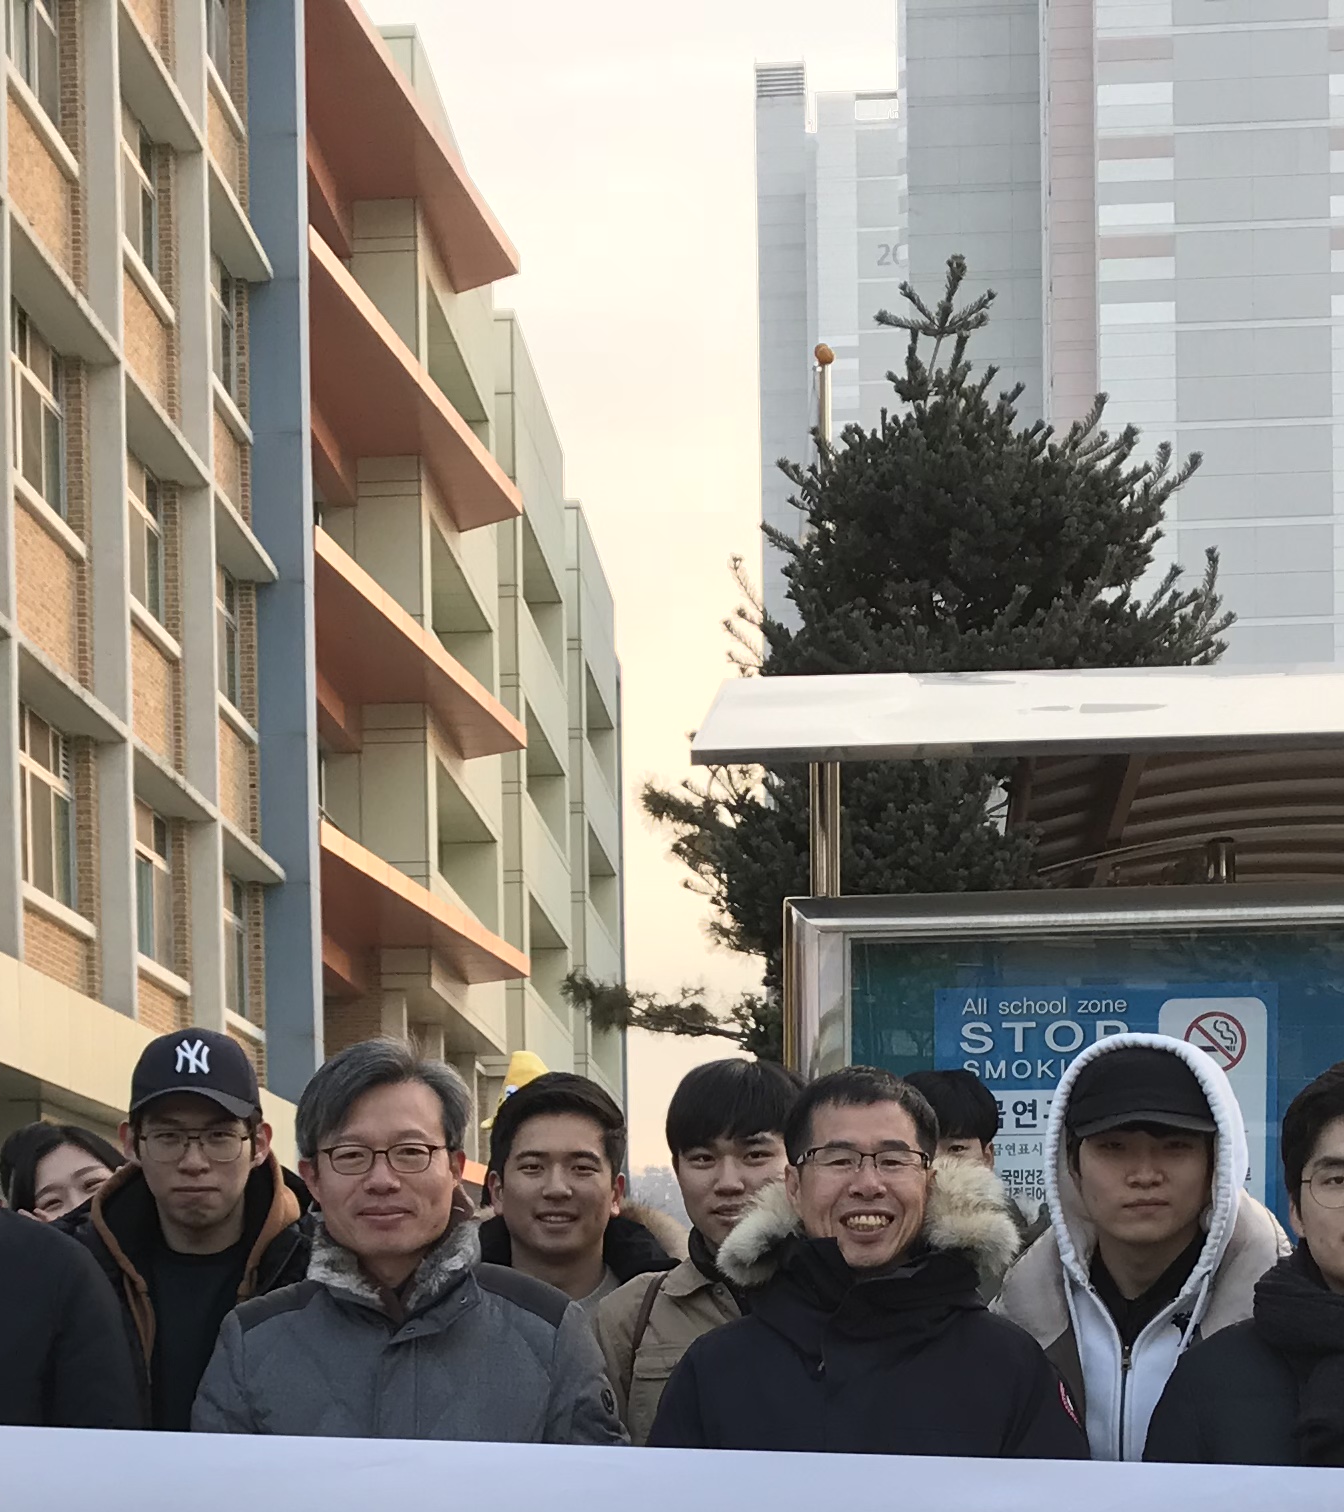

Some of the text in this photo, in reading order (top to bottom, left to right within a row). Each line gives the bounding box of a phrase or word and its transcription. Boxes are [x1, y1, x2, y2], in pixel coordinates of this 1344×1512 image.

[961, 996, 1128, 1015] All school zone
[175, 1039, 210, 1074] NY
